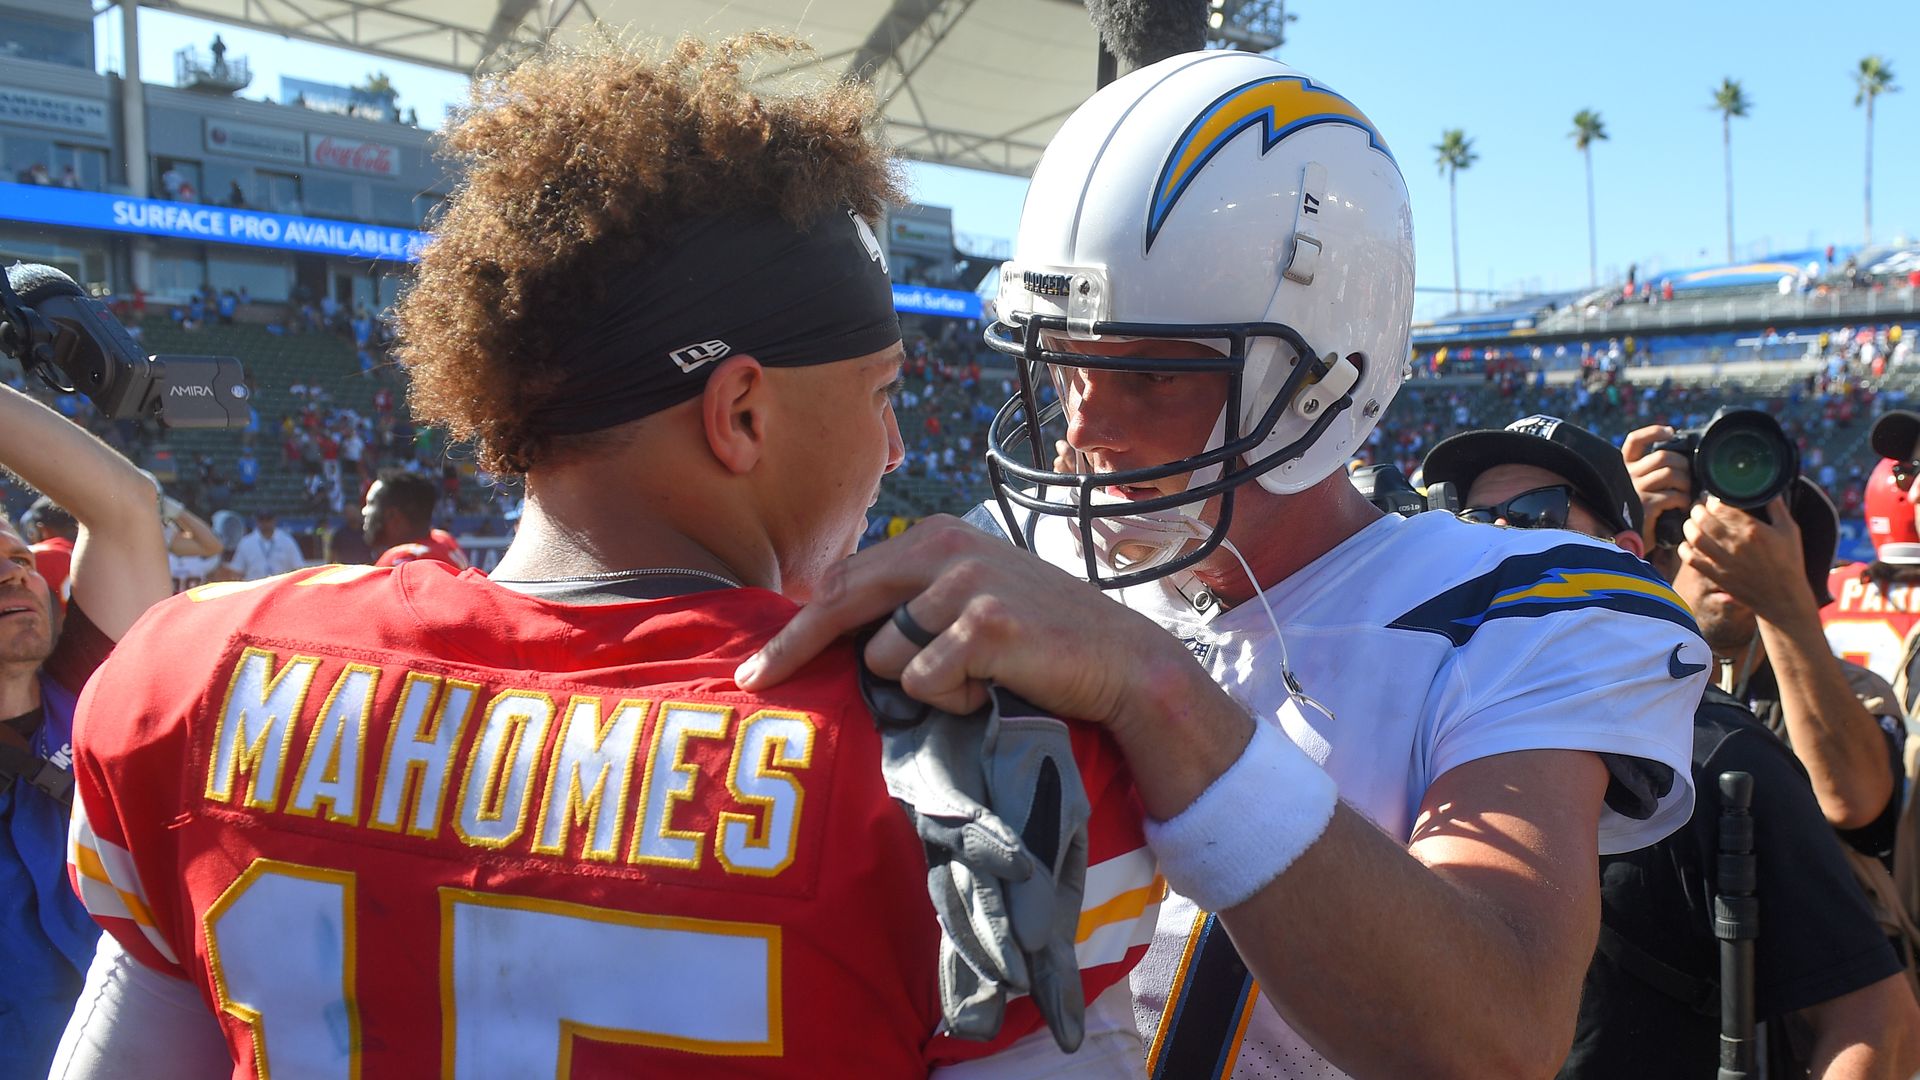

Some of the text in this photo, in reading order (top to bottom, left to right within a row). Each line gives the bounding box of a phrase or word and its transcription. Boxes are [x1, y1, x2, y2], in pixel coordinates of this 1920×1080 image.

[113, 200, 225, 236] SURFACE
[230, 213, 281, 242] PRO
[284, 220, 402, 255] AVAILABLE
[1303, 192, 1320, 215] 17
[169, 385, 214, 397] AMIRA
[204, 646, 815, 878] MAHOMES
[203, 857, 784, 1080] 15
